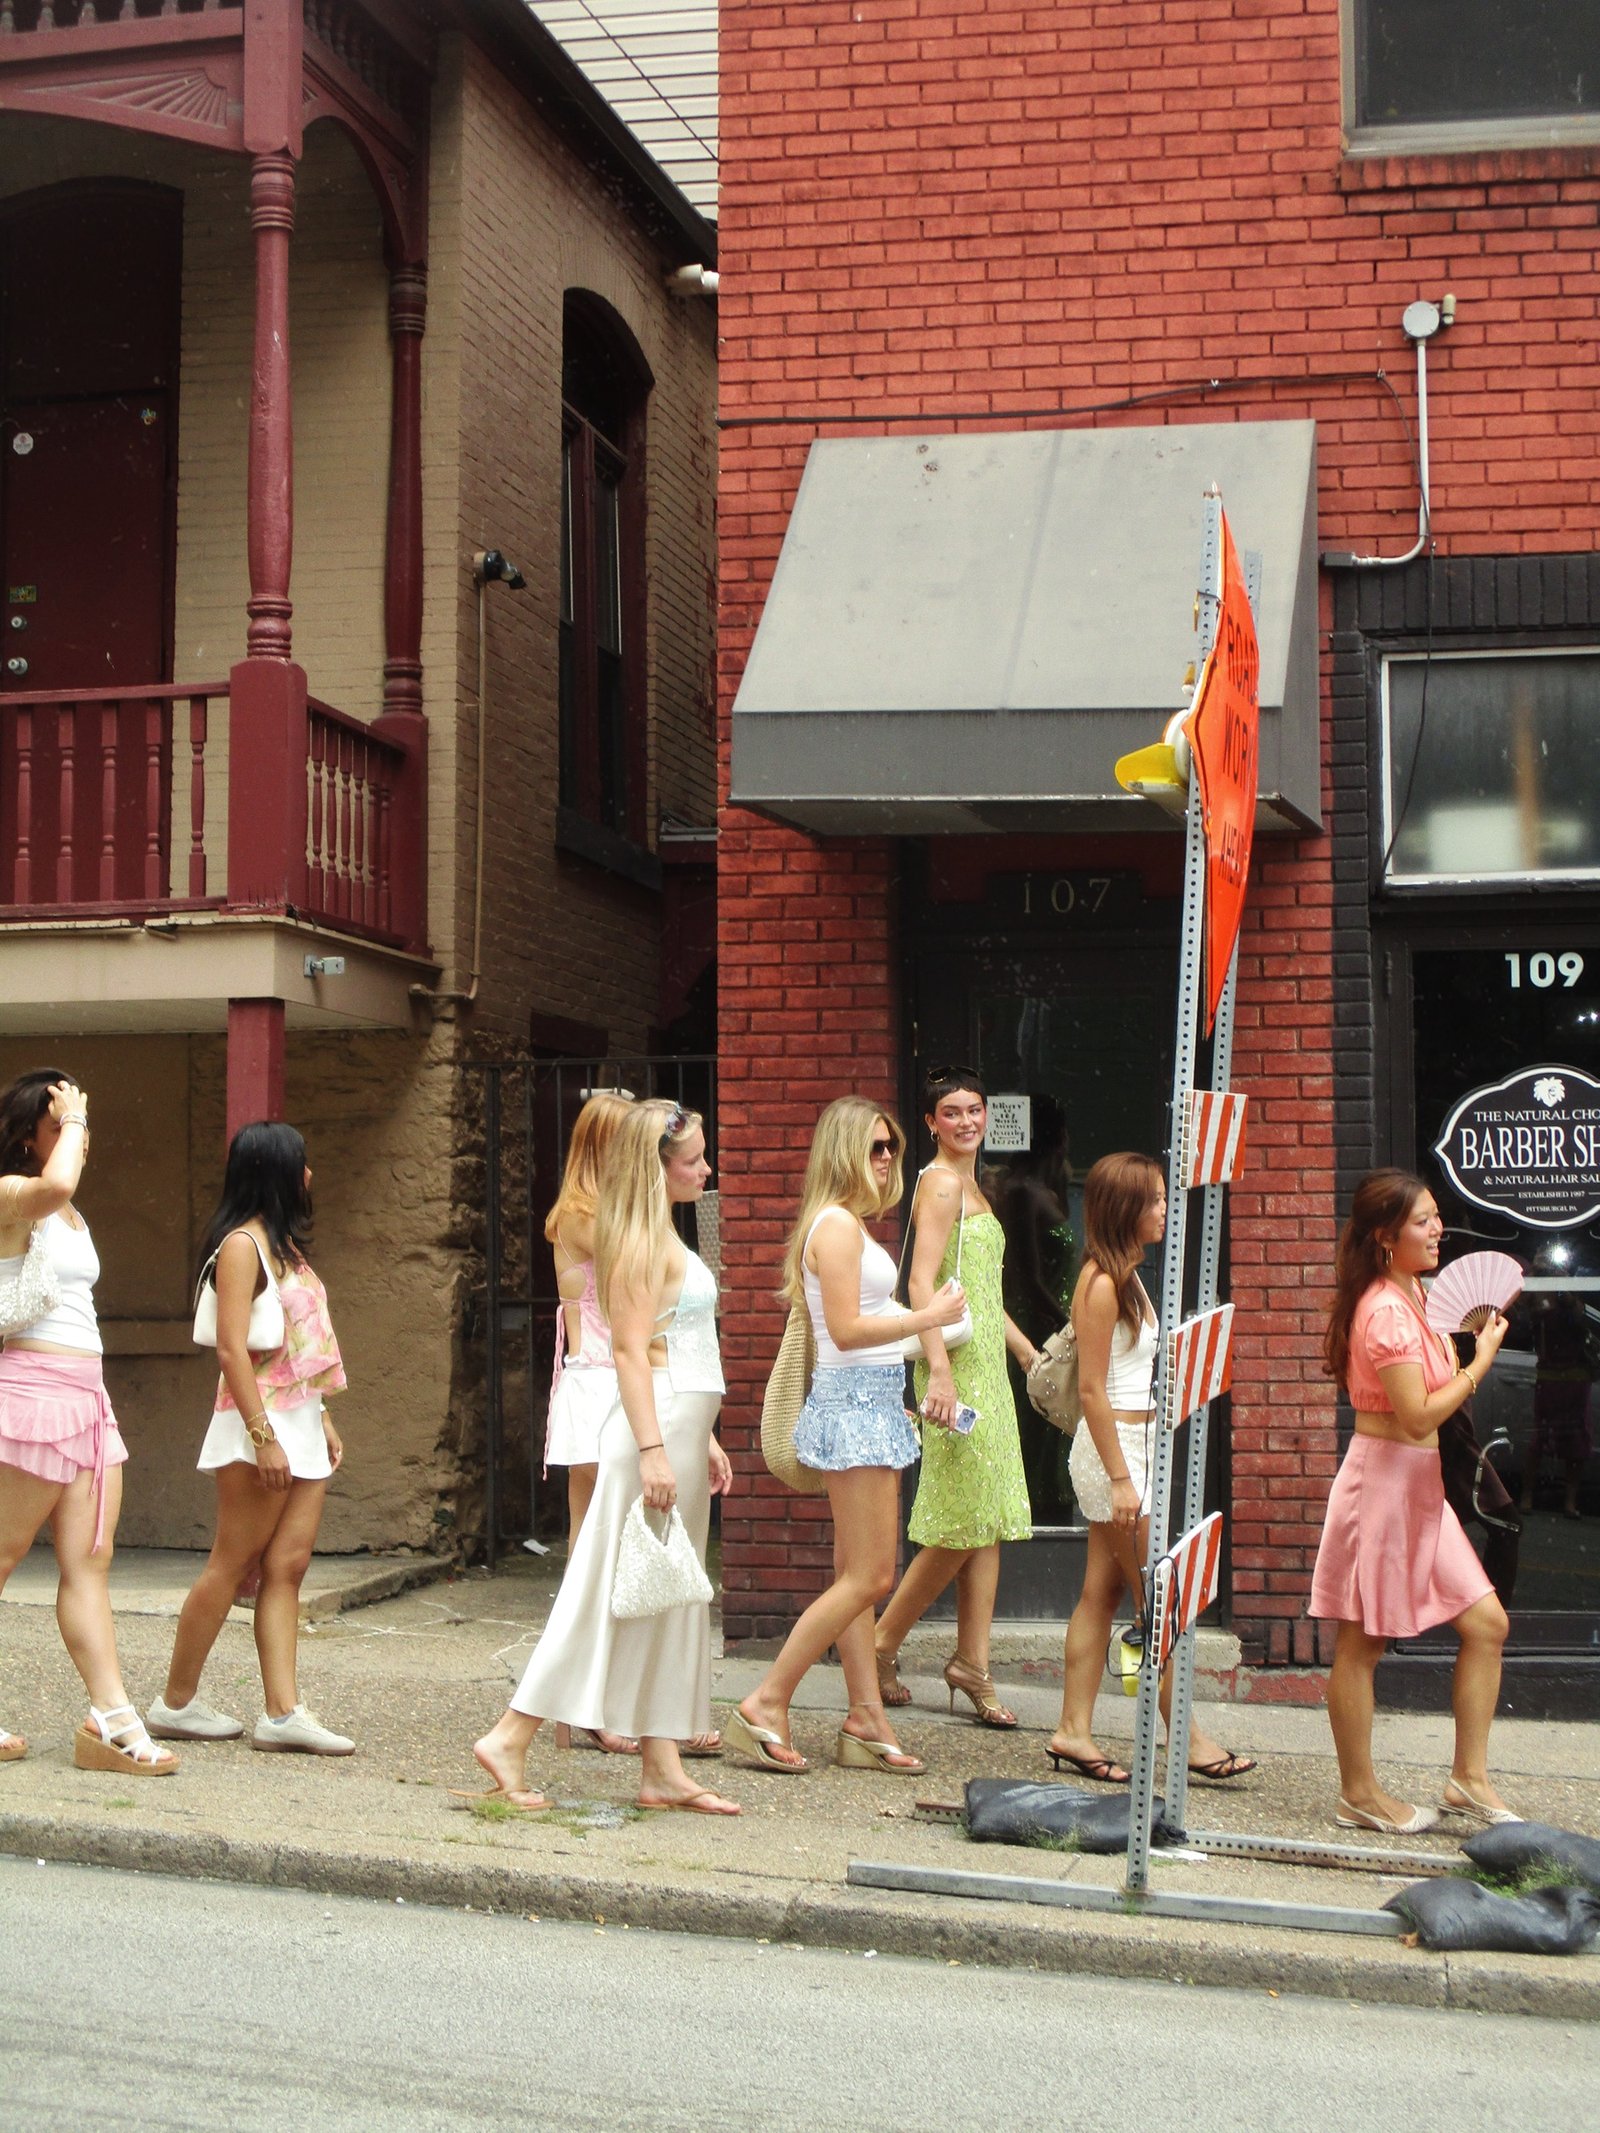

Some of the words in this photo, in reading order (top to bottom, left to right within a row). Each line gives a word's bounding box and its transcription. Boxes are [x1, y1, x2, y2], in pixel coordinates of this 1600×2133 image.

[1024, 878, 1111, 912] 107
[1505, 952, 1584, 988] 109
[1474, 1110, 1502, 1122] THE
[1505, 1109, 1570, 1121] NATURAL
[1460, 1127, 1569, 1169] BARBER
[1483, 1176, 1493, 1186] &
[1495, 1174, 1549, 1185] NATURAL
[1550, 1174, 1579, 1184] HAIR
[1518, 1191, 1569, 1199] ESTABLISHED
